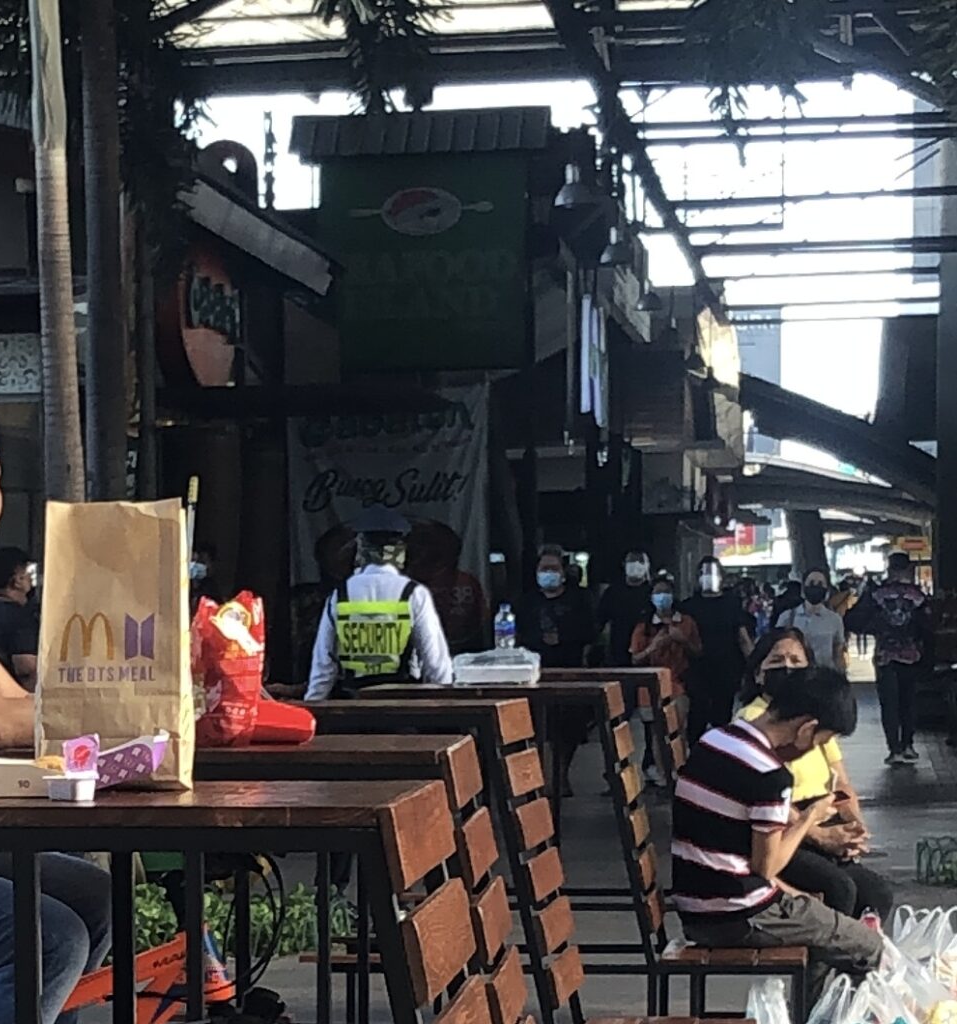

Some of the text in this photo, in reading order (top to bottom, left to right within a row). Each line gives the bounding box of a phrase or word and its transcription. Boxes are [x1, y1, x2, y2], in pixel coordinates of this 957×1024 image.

[343, 622, 402, 654] SECURITY
[58, 665, 156, 683] THE BTS MEAL
